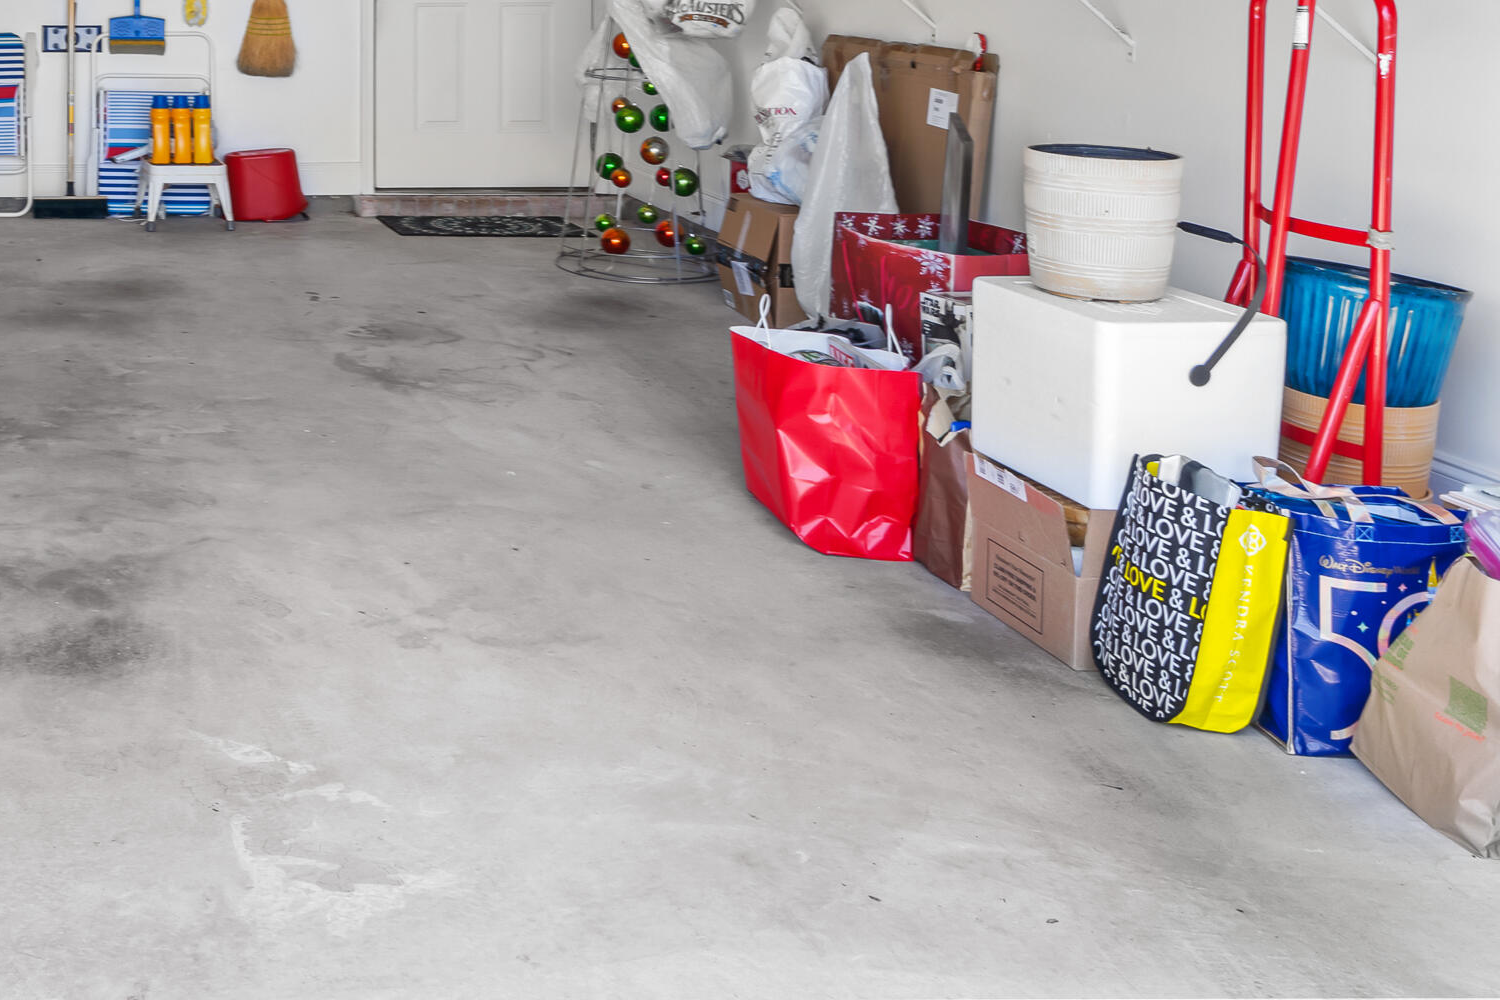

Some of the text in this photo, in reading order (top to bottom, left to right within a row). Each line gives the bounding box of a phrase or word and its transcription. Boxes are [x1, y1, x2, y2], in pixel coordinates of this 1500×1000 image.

[1135, 480, 1178, 521] LOVE
[1180, 506, 1198, 530] &
[1131, 521, 1173, 561] LOVE
[1175, 547, 1192, 571] &
[1146, 512, 1206, 554] LOVE
[1124, 561, 1167, 602] LOVE
[1169, 588, 1184, 611] &
[1140, 552, 1199, 595] LOVE
[1319, 554, 1348, 572] Walt
[1345, 558, 1394, 579] Disney
[1118, 599, 1160, 642] LOVE
[1161, 628, 1176, 652] &
[1136, 591, 1192, 636] LOVE
[1214, 564, 1254, 704] KENDRA SCOTT
[1113, 638, 1156, 683] LOVE
[1158, 669, 1172, 693] &
[1173, 678, 1188, 701] L
[1121, 623, 1132, 645] &
[1133, 631, 1182, 677] LOVE
[1118, 663, 1131, 686] &
[1131, 671, 1177, 715] LOVE
